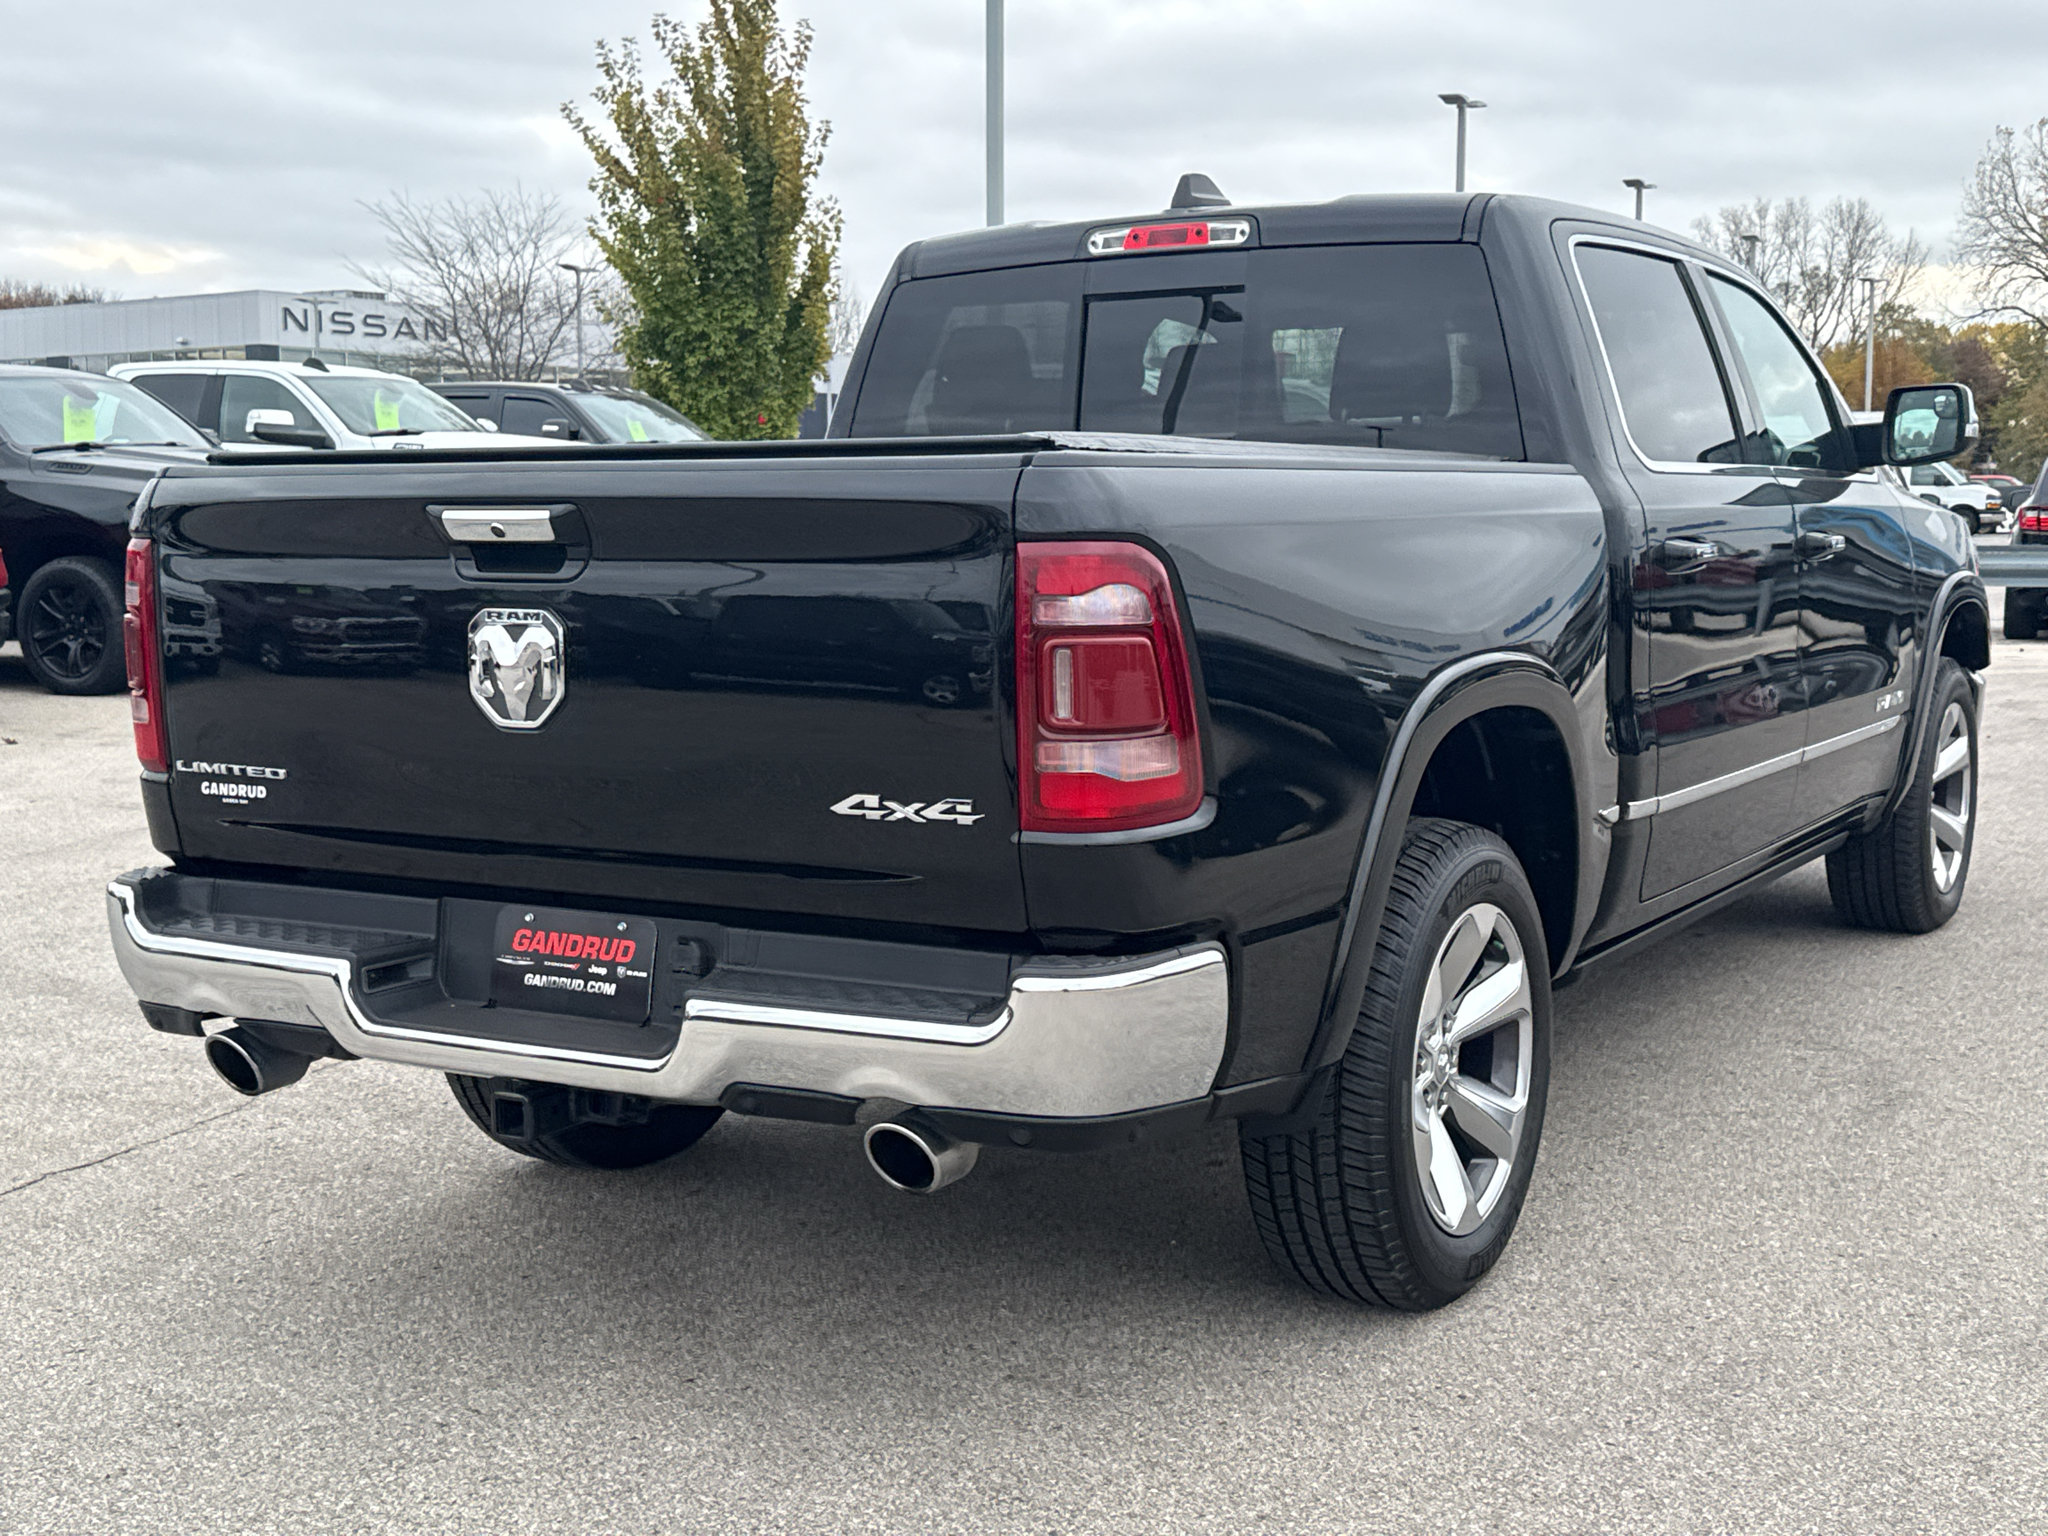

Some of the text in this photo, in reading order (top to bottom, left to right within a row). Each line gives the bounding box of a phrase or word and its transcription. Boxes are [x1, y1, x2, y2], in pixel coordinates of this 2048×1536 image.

[282, 306, 448, 342] NISSAN
[486, 611, 542, 622] RAM
[176, 760, 287, 780] LIMITED
[201, 781, 267, 798] GANDRUD
[512, 928, 636, 963] GANDRUD
[588, 964, 607, 976] Jeep
[524, 973, 617, 996] GANDRUD.COM
